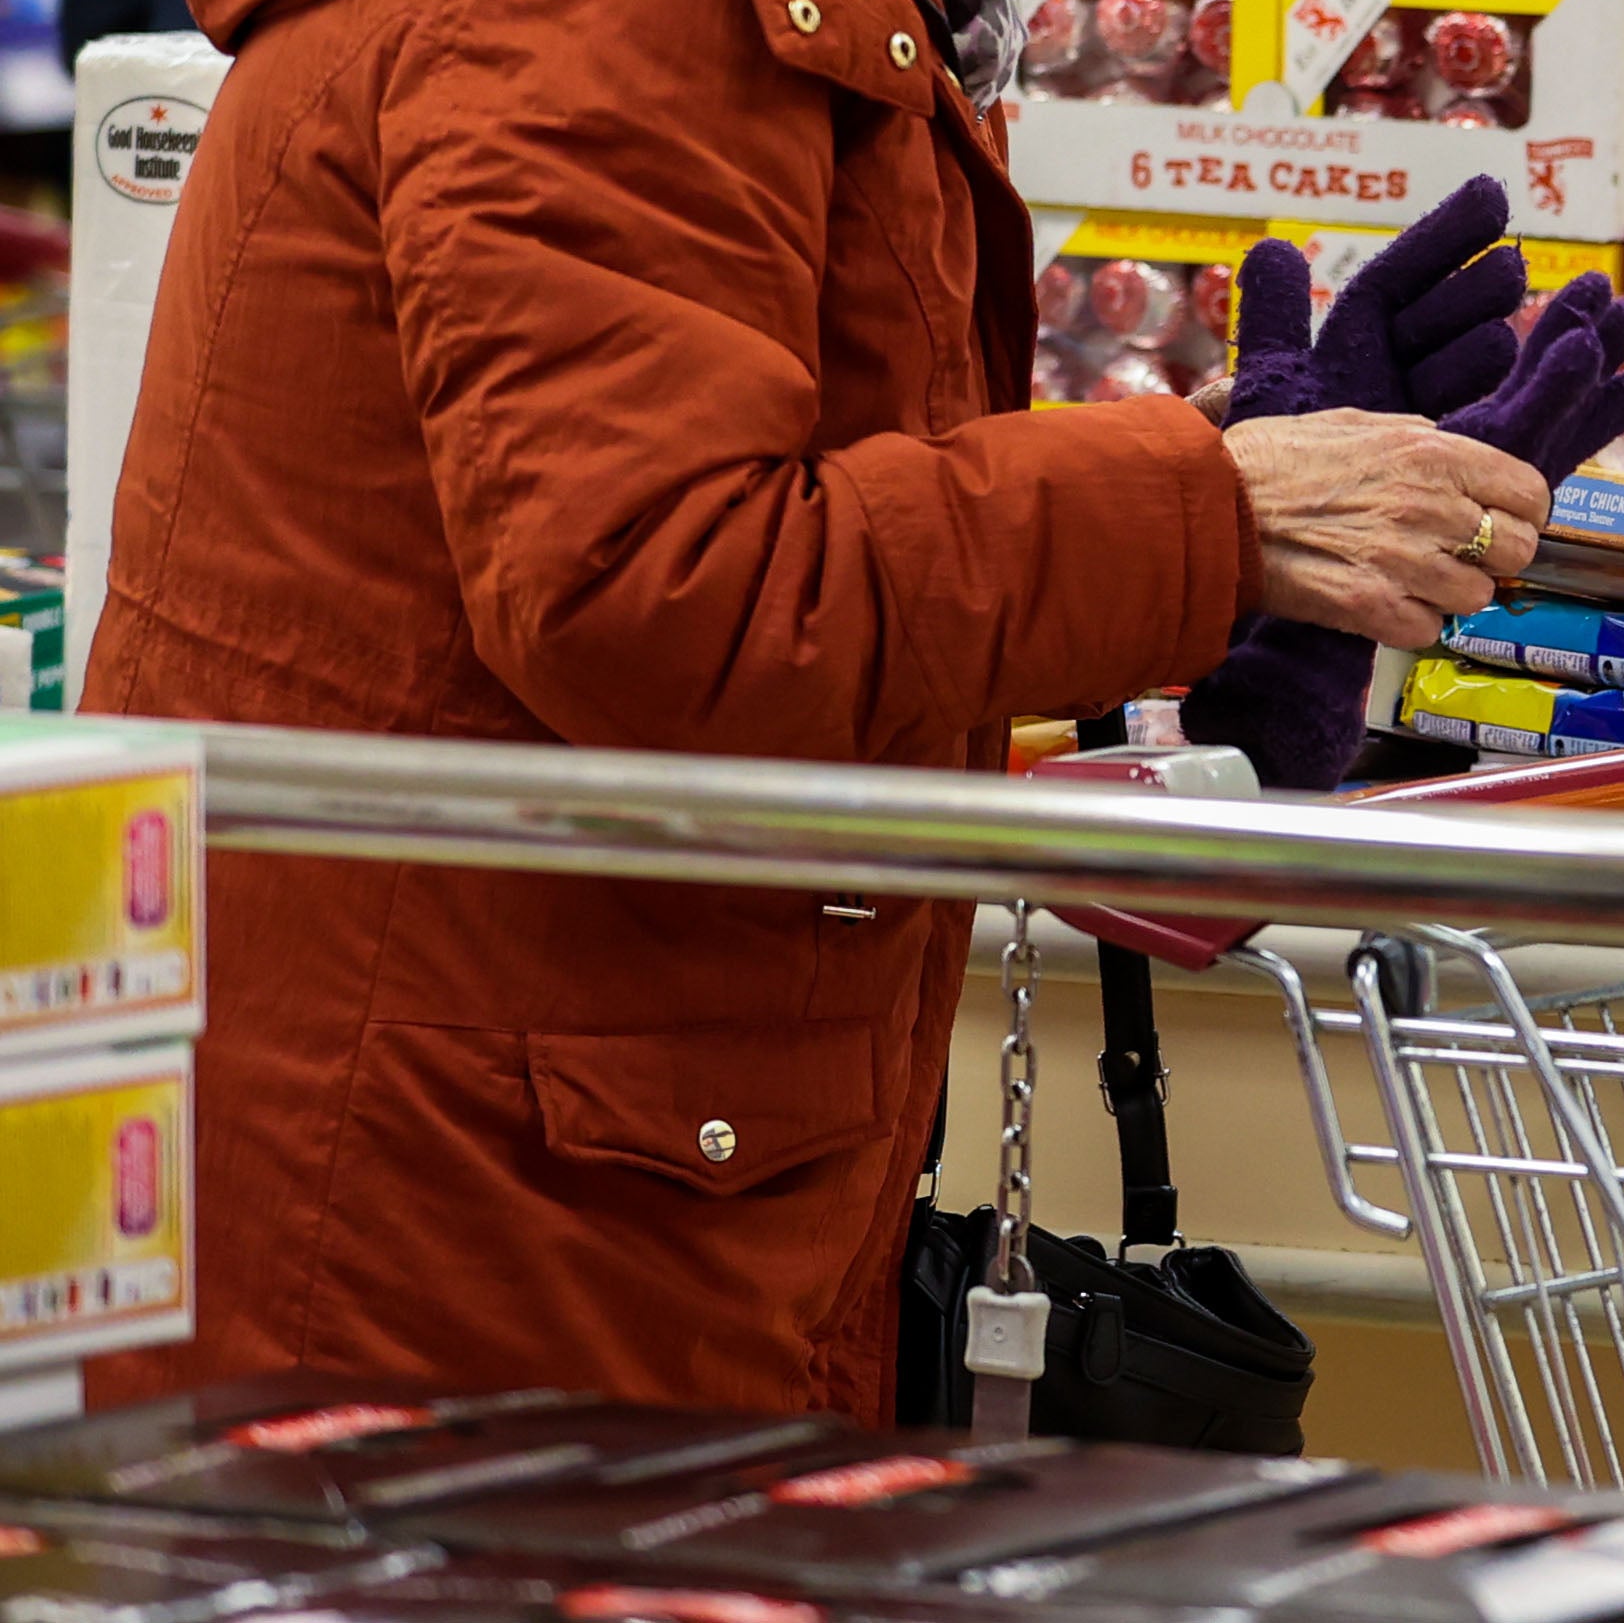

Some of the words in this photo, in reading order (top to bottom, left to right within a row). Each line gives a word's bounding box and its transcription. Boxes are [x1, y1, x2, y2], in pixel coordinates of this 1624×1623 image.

[1176, 122, 1227, 145] MILK
[1231, 124, 1361, 155] CHOCOLATE
[1130, 149, 1152, 191] 6
[1164, 156, 1257, 193] TEA
[1268, 161, 1410, 203] CAKES
